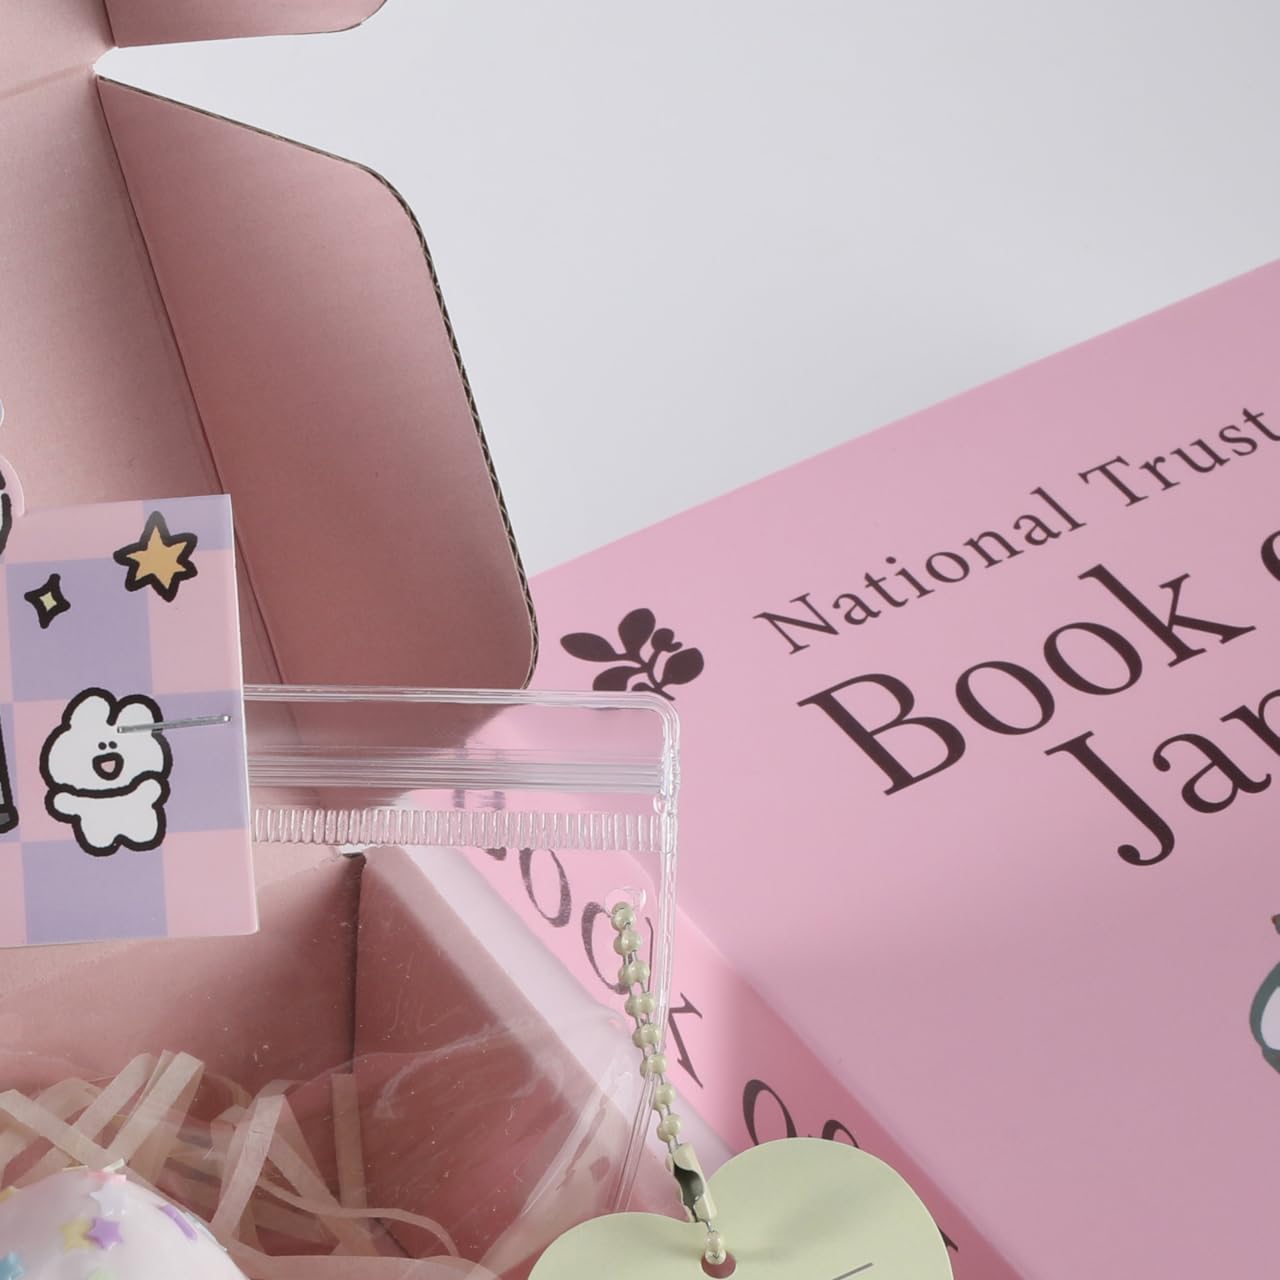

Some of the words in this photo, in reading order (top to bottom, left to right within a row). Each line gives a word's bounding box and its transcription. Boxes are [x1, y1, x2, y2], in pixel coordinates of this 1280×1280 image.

[753, 486, 1087, 655] National
[1078, 407, 1280, 507] Trust
[796, 563, 1257, 796] Book
